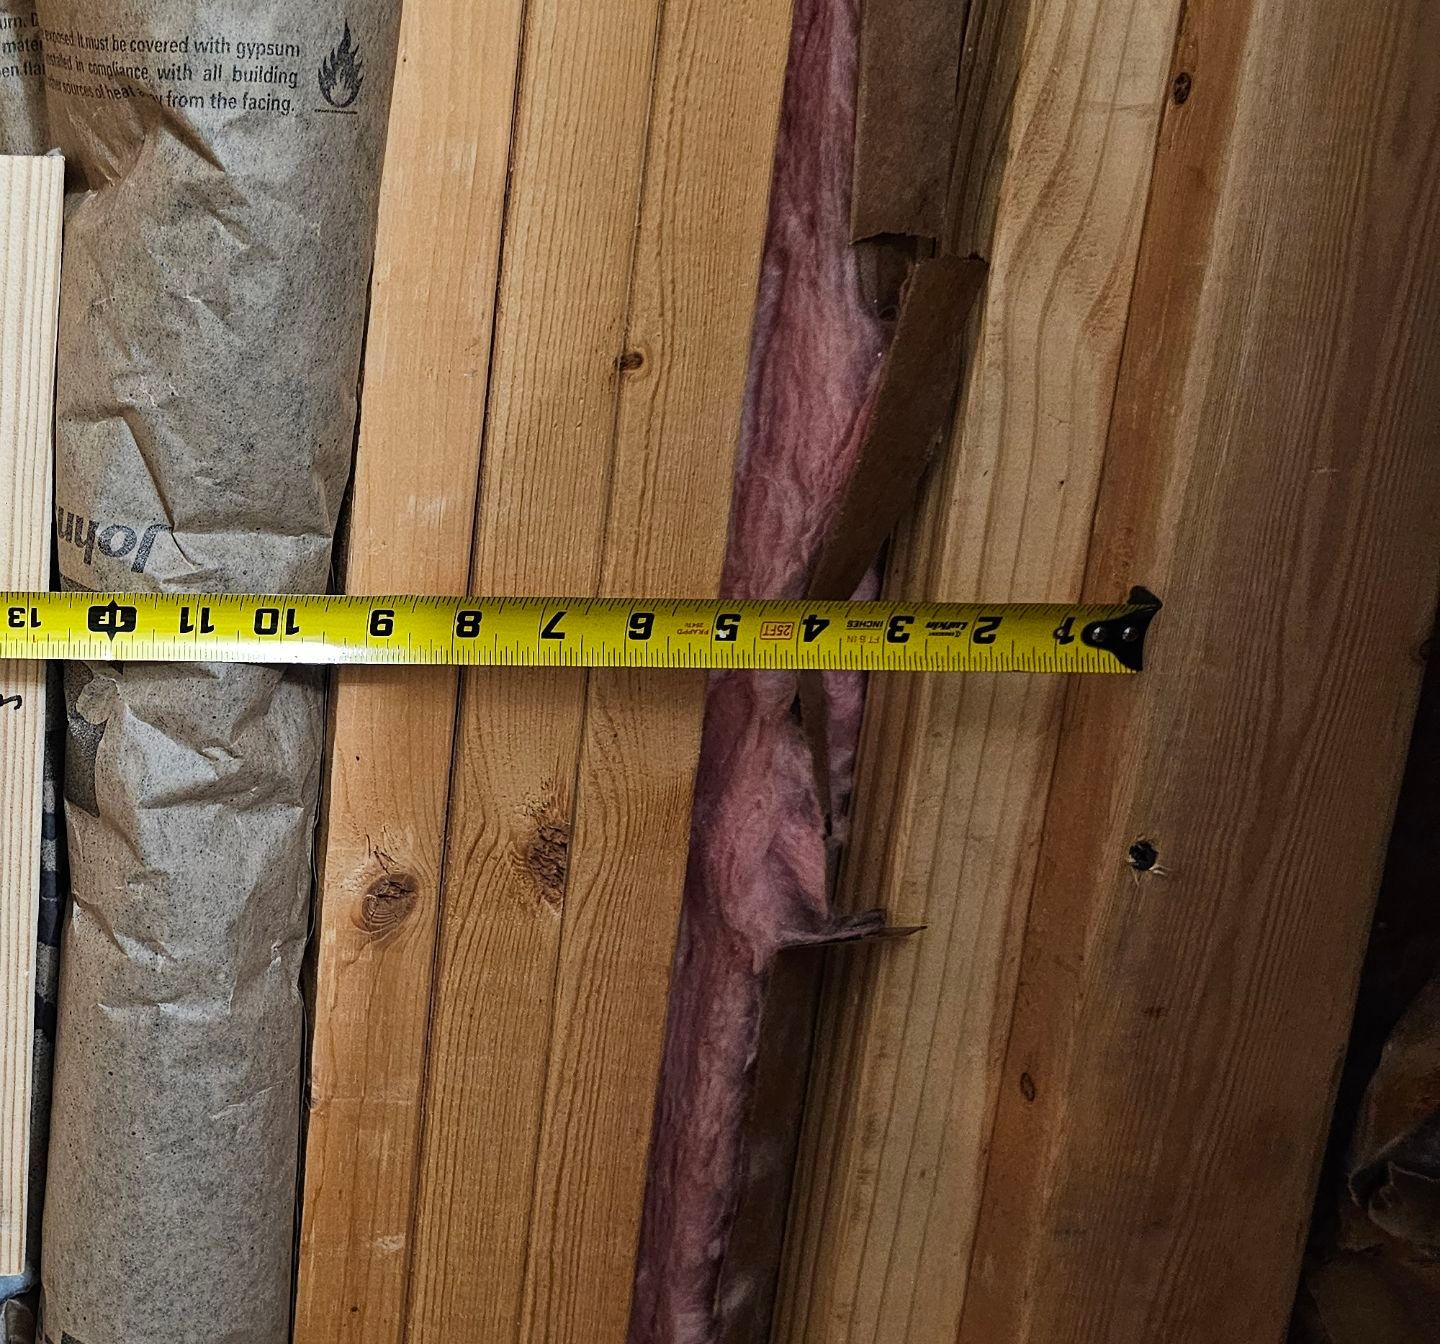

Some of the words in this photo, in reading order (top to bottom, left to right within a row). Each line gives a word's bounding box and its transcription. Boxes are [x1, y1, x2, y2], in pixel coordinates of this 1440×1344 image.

[112, 34, 127, 53] be
[130, 36, 190, 54] covered
[194, 36, 231, 54] with
[236, 41, 300, 60] gypsum
[157, 63, 193, 82] with
[203, 64, 222, 82] all
[232, 65, 298, 89] building
[105, 84, 136, 100] heat
[167, 90, 204, 110] from
[211, 91, 237, 110] the
[242, 91, 295, 115] facing.
[8, 606, 42, 628] 13
[179, 607, 215, 635] 11
[253, 608, 300, 636] 10
[369, 609, 395, 637] 9
[456, 610, 483, 639] 8
[540, 611, 568, 640] 7
[627, 612, 655, 641] 6
[714, 613, 742, 642] 5
[762, 623, 791, 638] 25FT
[802, 614, 830, 643] 4
[846, 619, 884, 629] INCHES
[886, 615, 915, 644] 3
[924, 621, 969, 631] Lufkin
[973, 616, 1003, 645] 2
